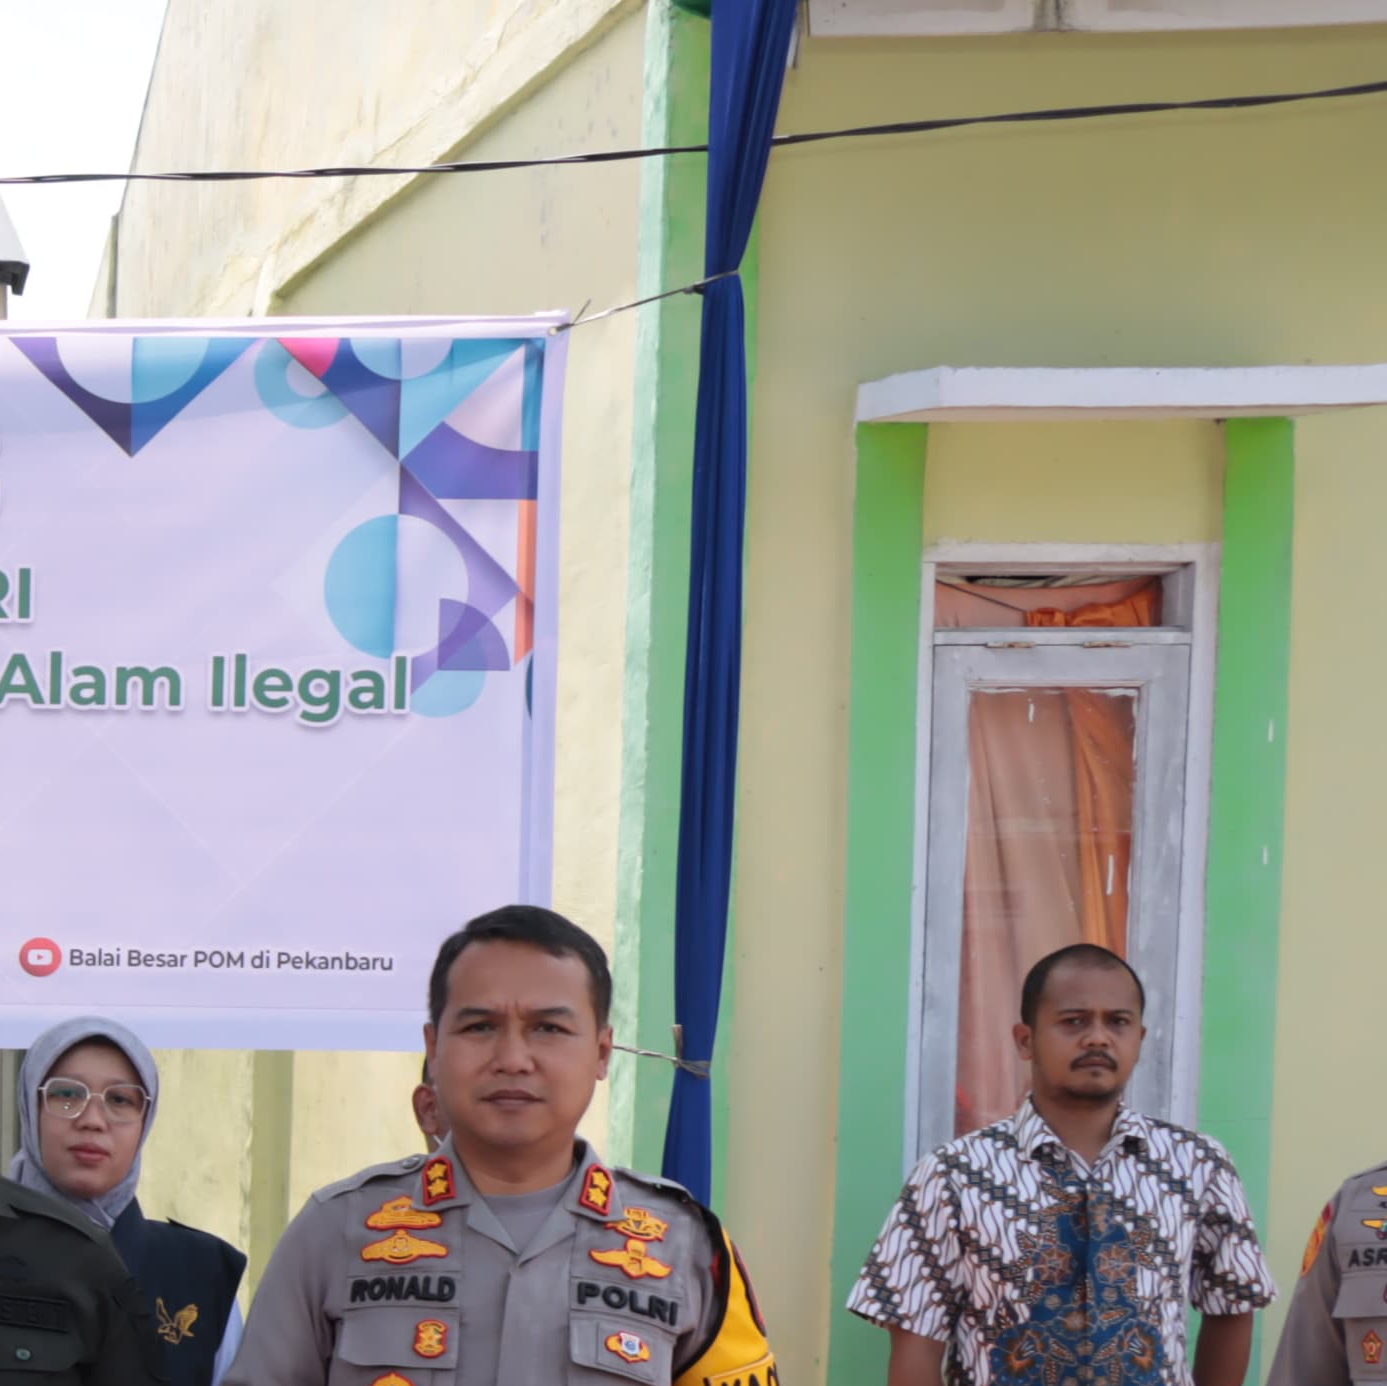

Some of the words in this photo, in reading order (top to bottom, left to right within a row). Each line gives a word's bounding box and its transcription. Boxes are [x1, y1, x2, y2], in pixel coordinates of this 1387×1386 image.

[210, 653, 410, 724] Ilegal
[69, 948, 121, 967] Balai
[128, 949, 188, 968] Besar
[194, 951, 245, 969] POM
[251, 950, 270, 969] di
[277, 951, 394, 971] Pekanbaru
[351, 1276, 456, 1301] RONALD
[577, 1281, 679, 1327] POLRI
